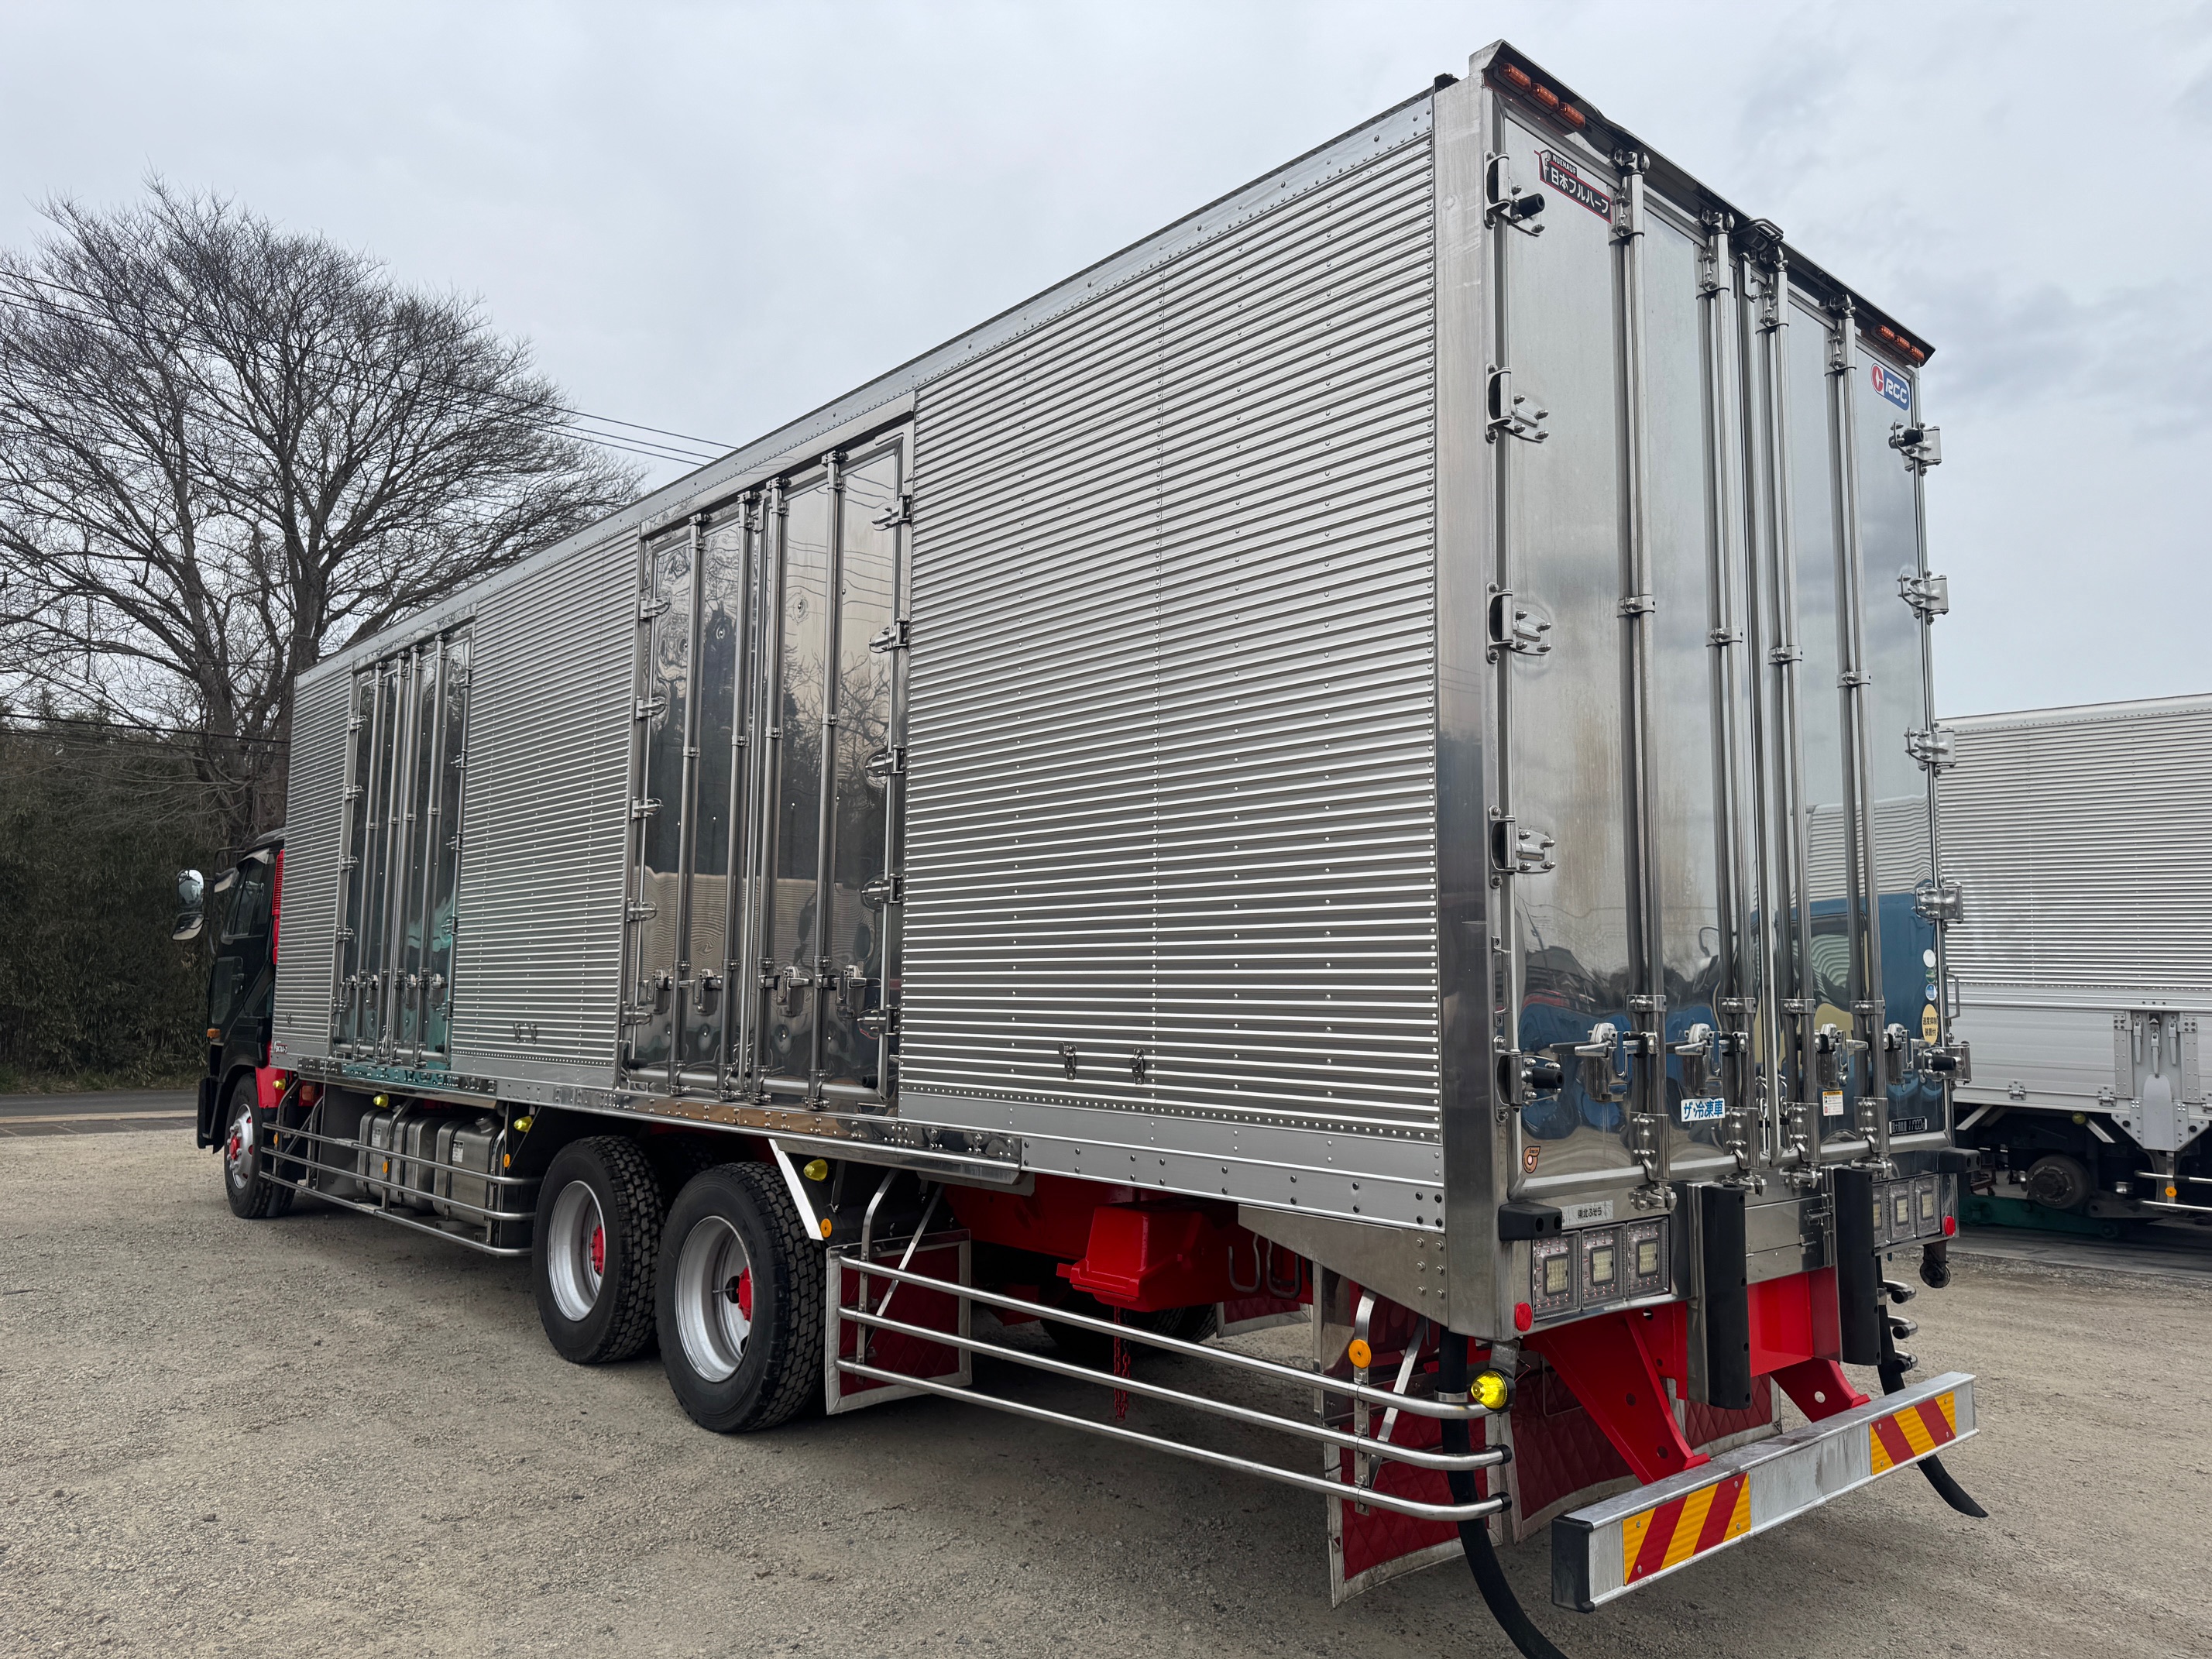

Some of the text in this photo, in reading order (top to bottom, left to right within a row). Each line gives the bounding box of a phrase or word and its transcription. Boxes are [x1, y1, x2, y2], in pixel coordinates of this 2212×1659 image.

[1551, 167, 1609, 214] 日本フルハーフ
[1885, 377, 1908, 404] RCC
[1578, 1207, 1602, 1219] 東北ふそう
